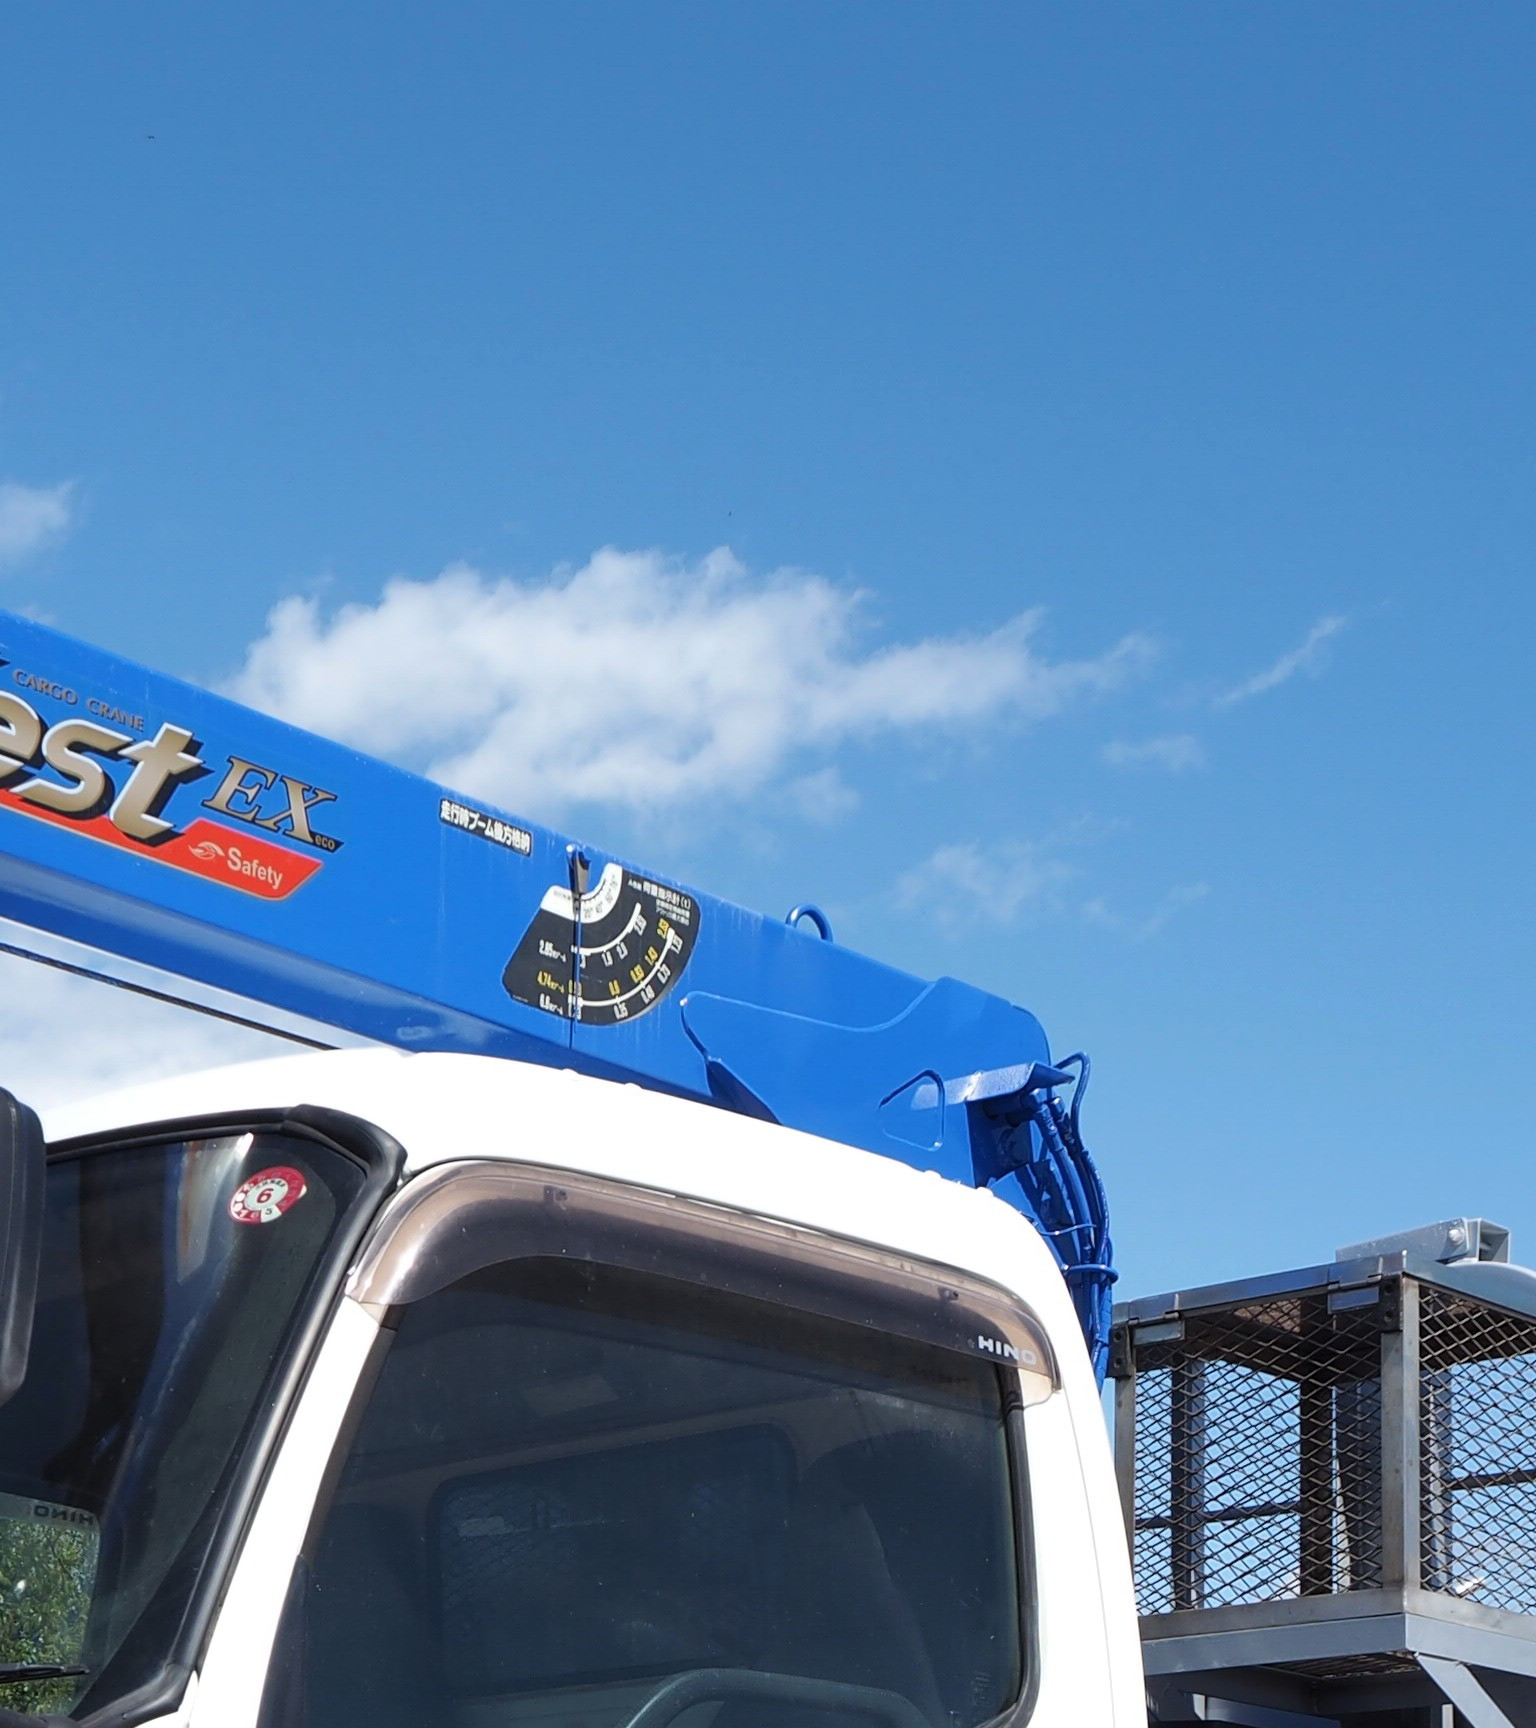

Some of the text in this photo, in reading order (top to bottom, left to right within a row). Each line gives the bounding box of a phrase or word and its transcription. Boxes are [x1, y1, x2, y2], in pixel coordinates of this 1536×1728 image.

[14, 669, 145, 732] CARGO CRANE
[202, 756, 338, 843] EX
[227, 846, 284, 890] Safety
[256, 1187, 275, 1204] 6
[978, 1335, 1037, 1366] HINO
